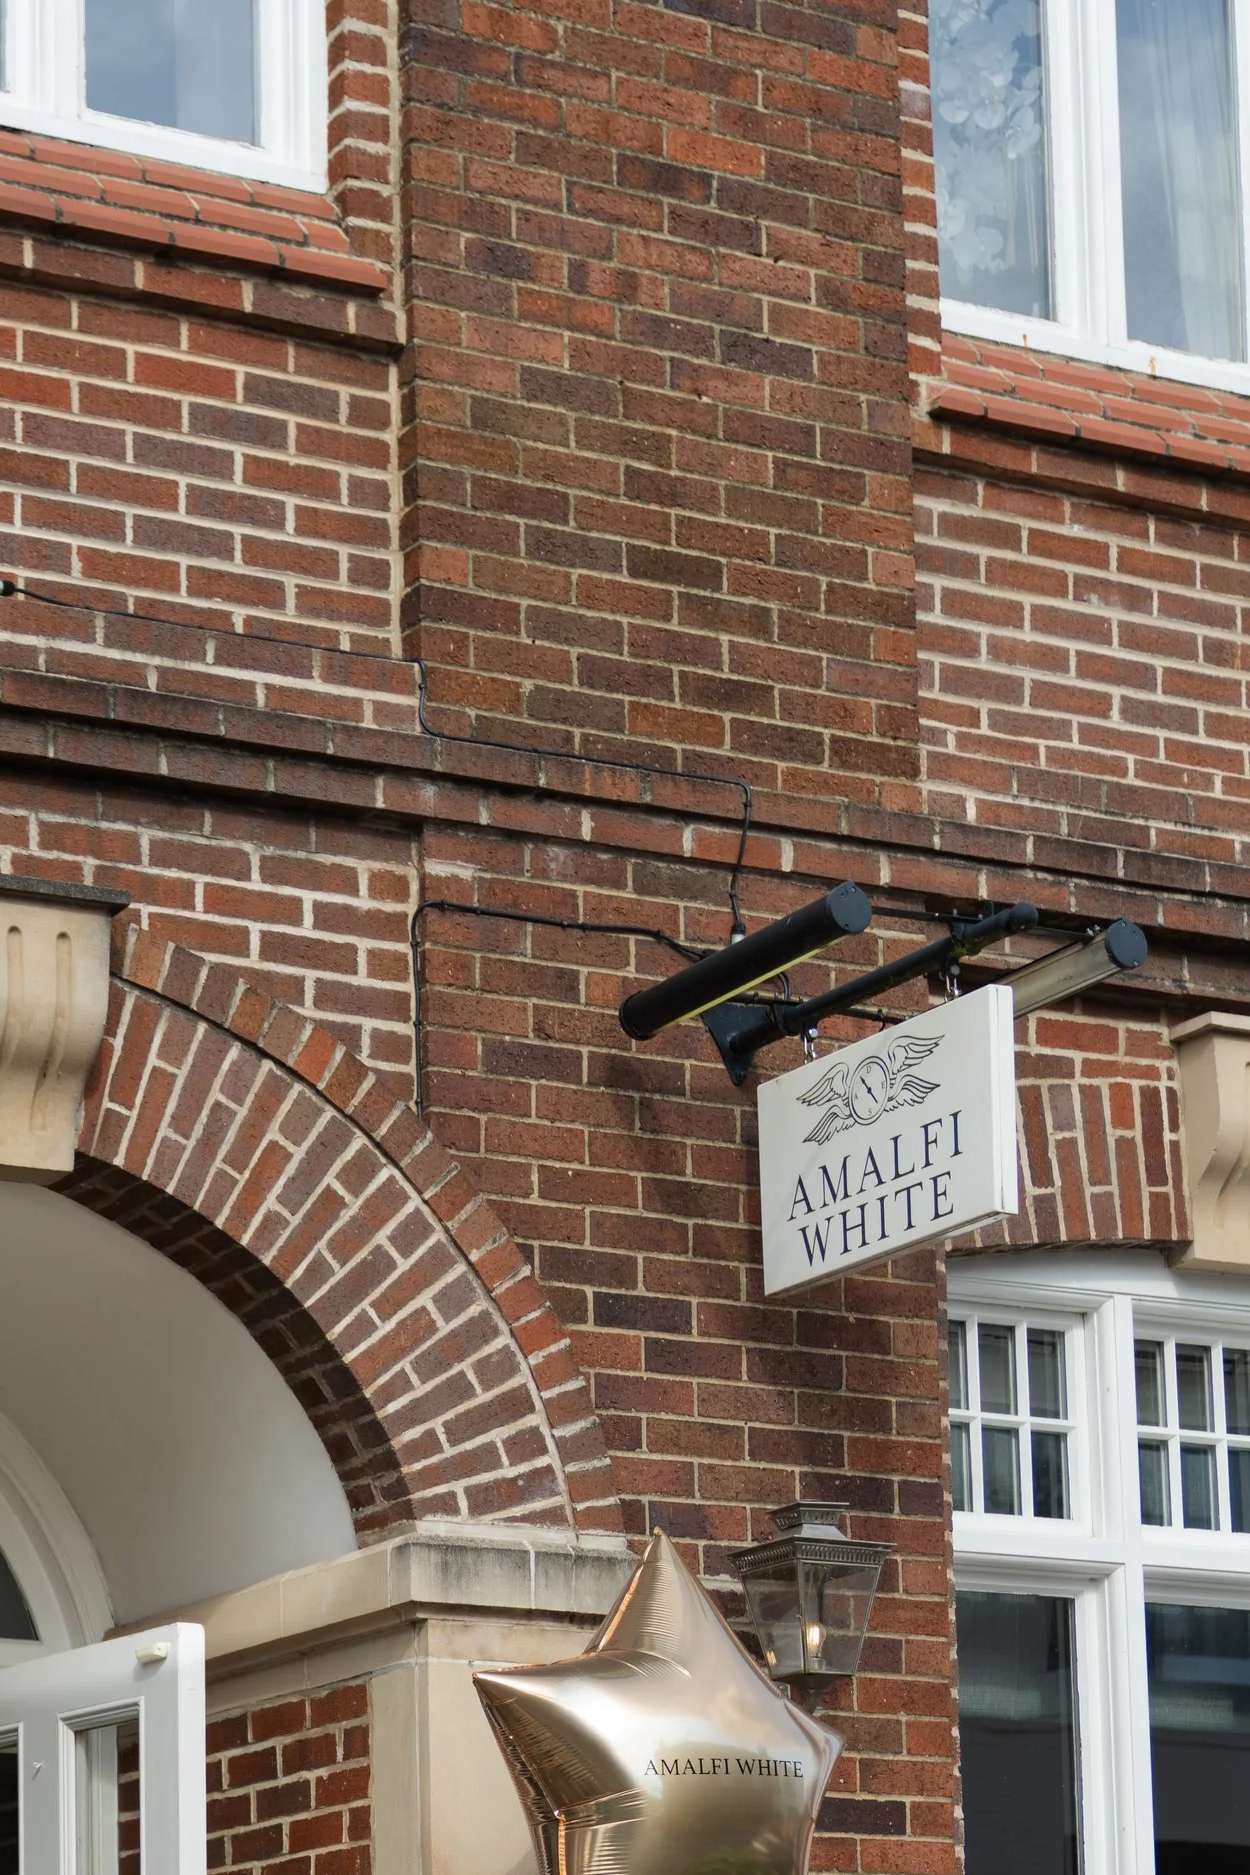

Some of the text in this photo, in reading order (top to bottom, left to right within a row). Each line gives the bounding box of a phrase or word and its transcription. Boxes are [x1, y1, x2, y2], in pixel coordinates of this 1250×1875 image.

[787, 1109, 964, 1222] AMALFI
[798, 1170, 954, 1267] WHITE
[644, 1758, 804, 1778] AMALFI WHITE
